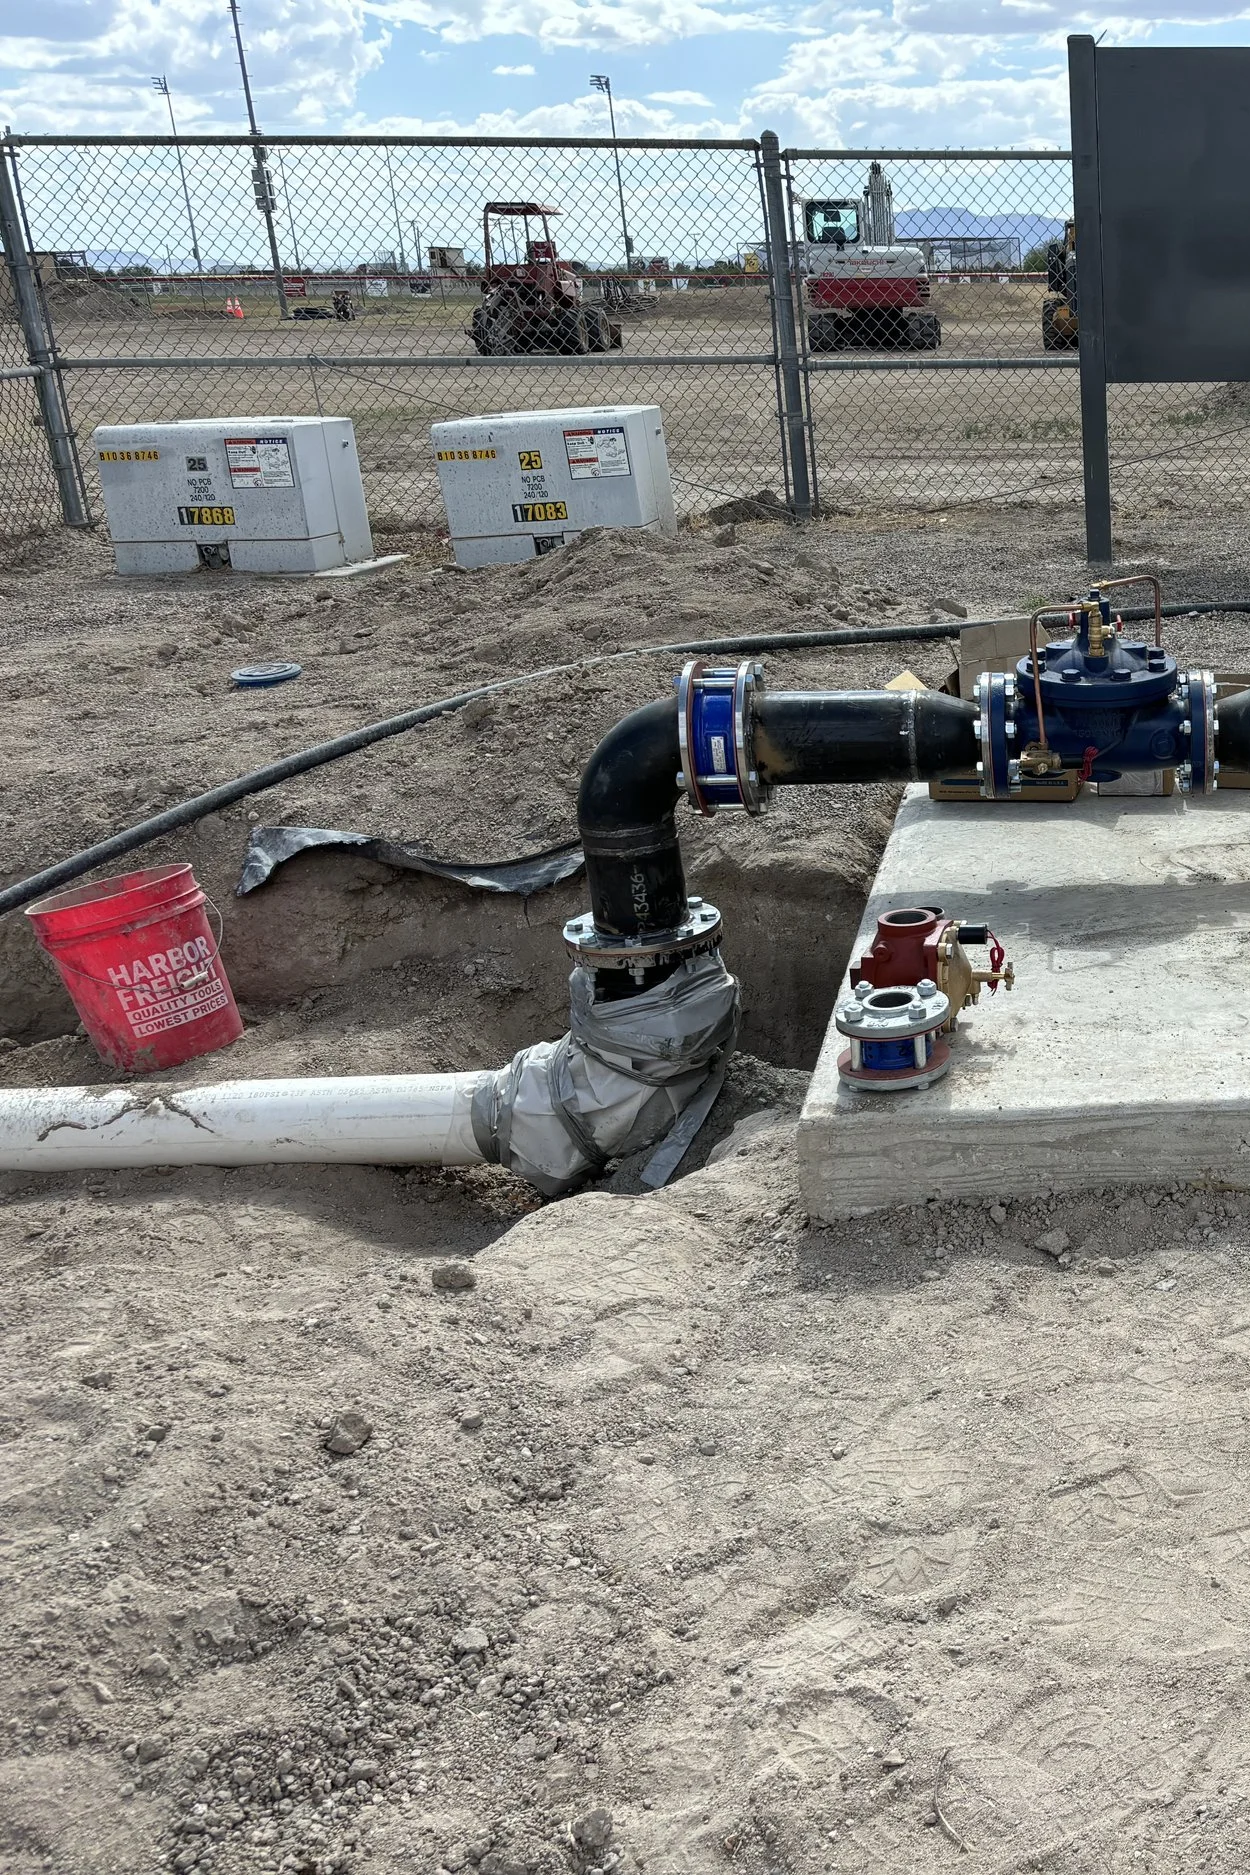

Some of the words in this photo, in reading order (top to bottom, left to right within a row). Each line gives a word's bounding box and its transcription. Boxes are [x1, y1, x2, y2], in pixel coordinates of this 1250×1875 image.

[134, 451, 159, 461] 8746
[472, 449, 496, 460] 8746
[520, 451, 541, 469] 25
[188, 458, 206, 471] 25
[532, 475, 545, 483] PCB
[193, 486, 209, 494] 7200
[527, 483, 543, 491] 7200
[190, 494, 216, 502] 240/120
[523, 491, 549, 499] 240/120
[179, 507, 235, 525] 17868
[515, 502, 567, 522] 17083
[107, 935, 211, 988] HARBOR
[116, 957, 217, 1011] FREIGHT
[132, 996, 188, 1021] QUALITY
[192, 981, 222, 1003] TOOLS
[138, 1012, 189, 1034] LOWEST
[192, 995, 226, 1017] PRICES
